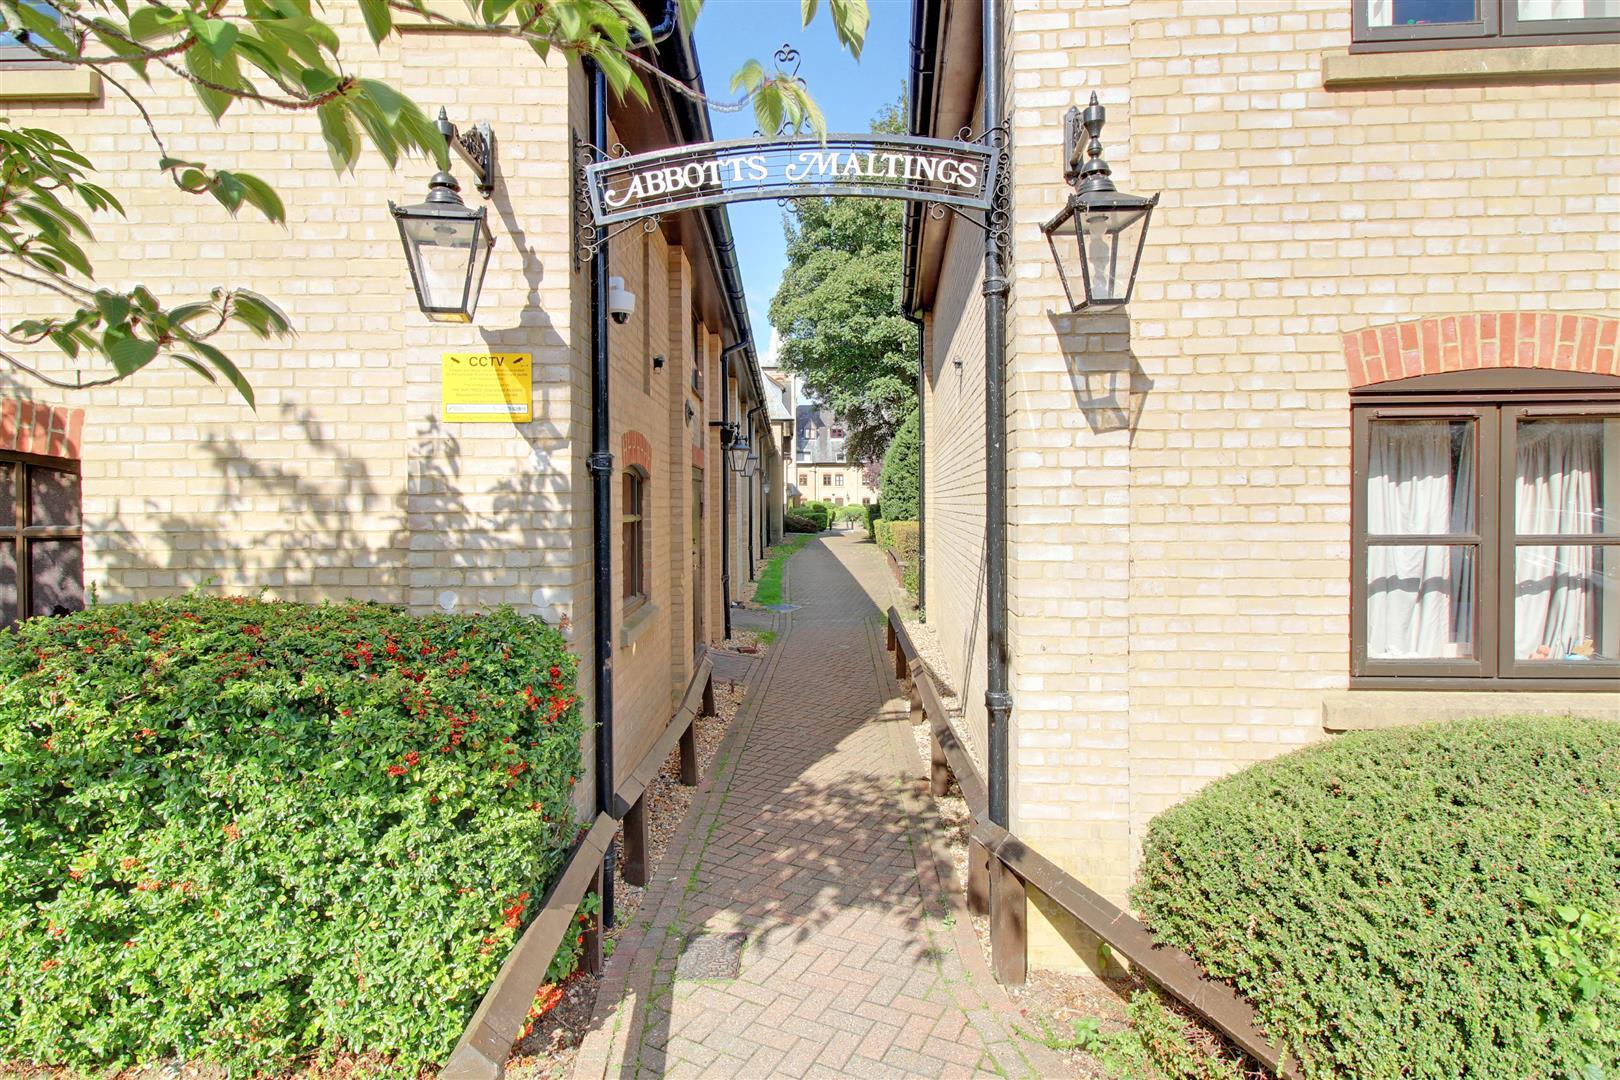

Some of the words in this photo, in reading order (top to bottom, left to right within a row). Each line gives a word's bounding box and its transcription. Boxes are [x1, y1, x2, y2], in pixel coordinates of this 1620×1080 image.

[604, 155, 768, 207] ABBOTTS
[785, 152, 978, 188] MALTINGS
[469, 356, 505, 367] CCTV
